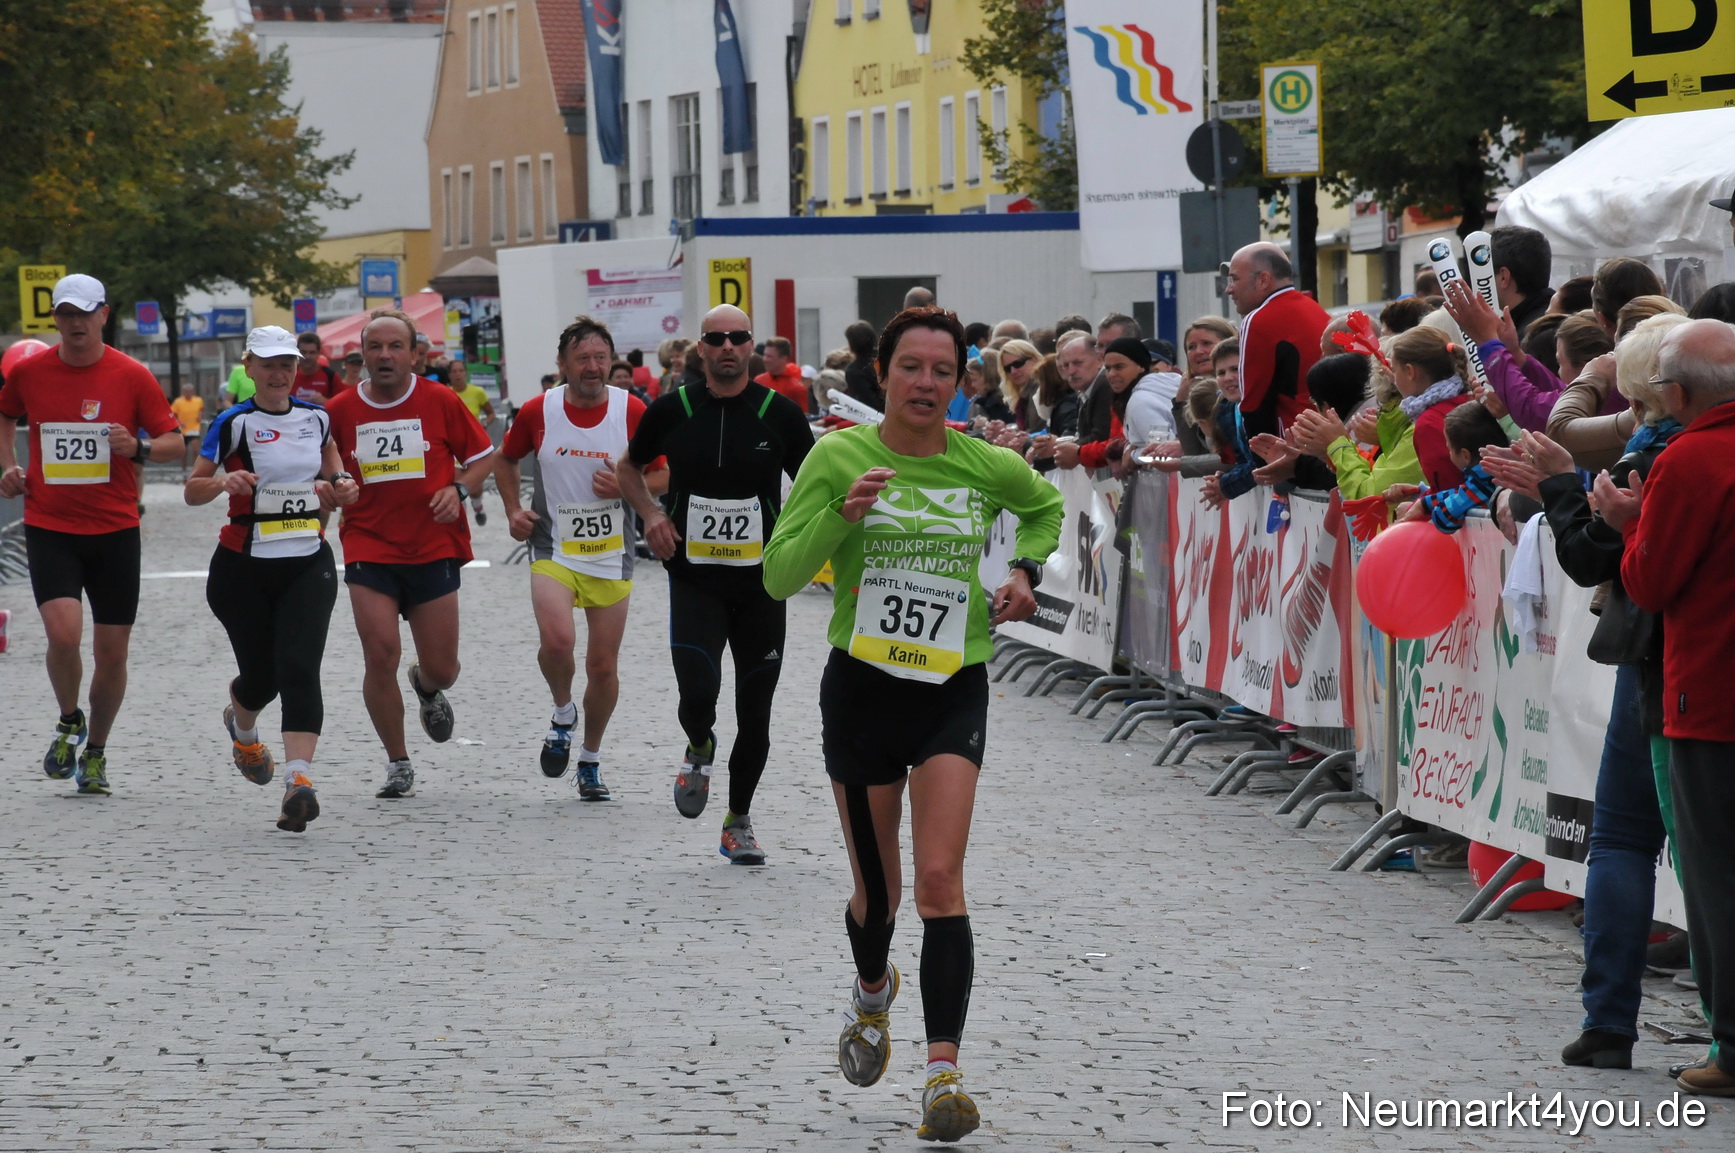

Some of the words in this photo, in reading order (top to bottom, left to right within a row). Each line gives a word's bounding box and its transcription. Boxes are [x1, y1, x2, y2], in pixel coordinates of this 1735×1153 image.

[1629, 0, 1718, 57] D
[853, 63, 883, 98] HOTEL
[1273, 118, 1309, 126] Marktplatz
[25, 268, 60, 281] Block
[713, 261, 747, 273] Block
[720, 278, 742, 307] D
[33, 286, 52, 318] D
[358, 428, 378, 437] PARTL
[379, 425, 410, 434] Neumarkt
[55, 438, 97, 460] 529
[376, 434, 403, 458] 24
[570, 449, 612, 459] KLEBL
[261, 488, 285, 496] PARTL
[581, 505, 612, 514] Neumarkt
[690, 502, 713, 512] PARTL
[714, 506, 751, 514] Neumarkt
[282, 520, 308, 529] Heide
[571, 513, 612, 538] 259
[702, 515, 749, 540] 242
[580, 542, 607, 553] Rainer
[710, 546, 741, 557] Zoltan
[863, 539, 984, 557] LANDKREISLAUF
[864, 577, 901, 590] PARTL
[904, 581, 955, 600] Neumarkt
[880, 595, 949, 642] 357
[888, 645, 927, 666] Karin
